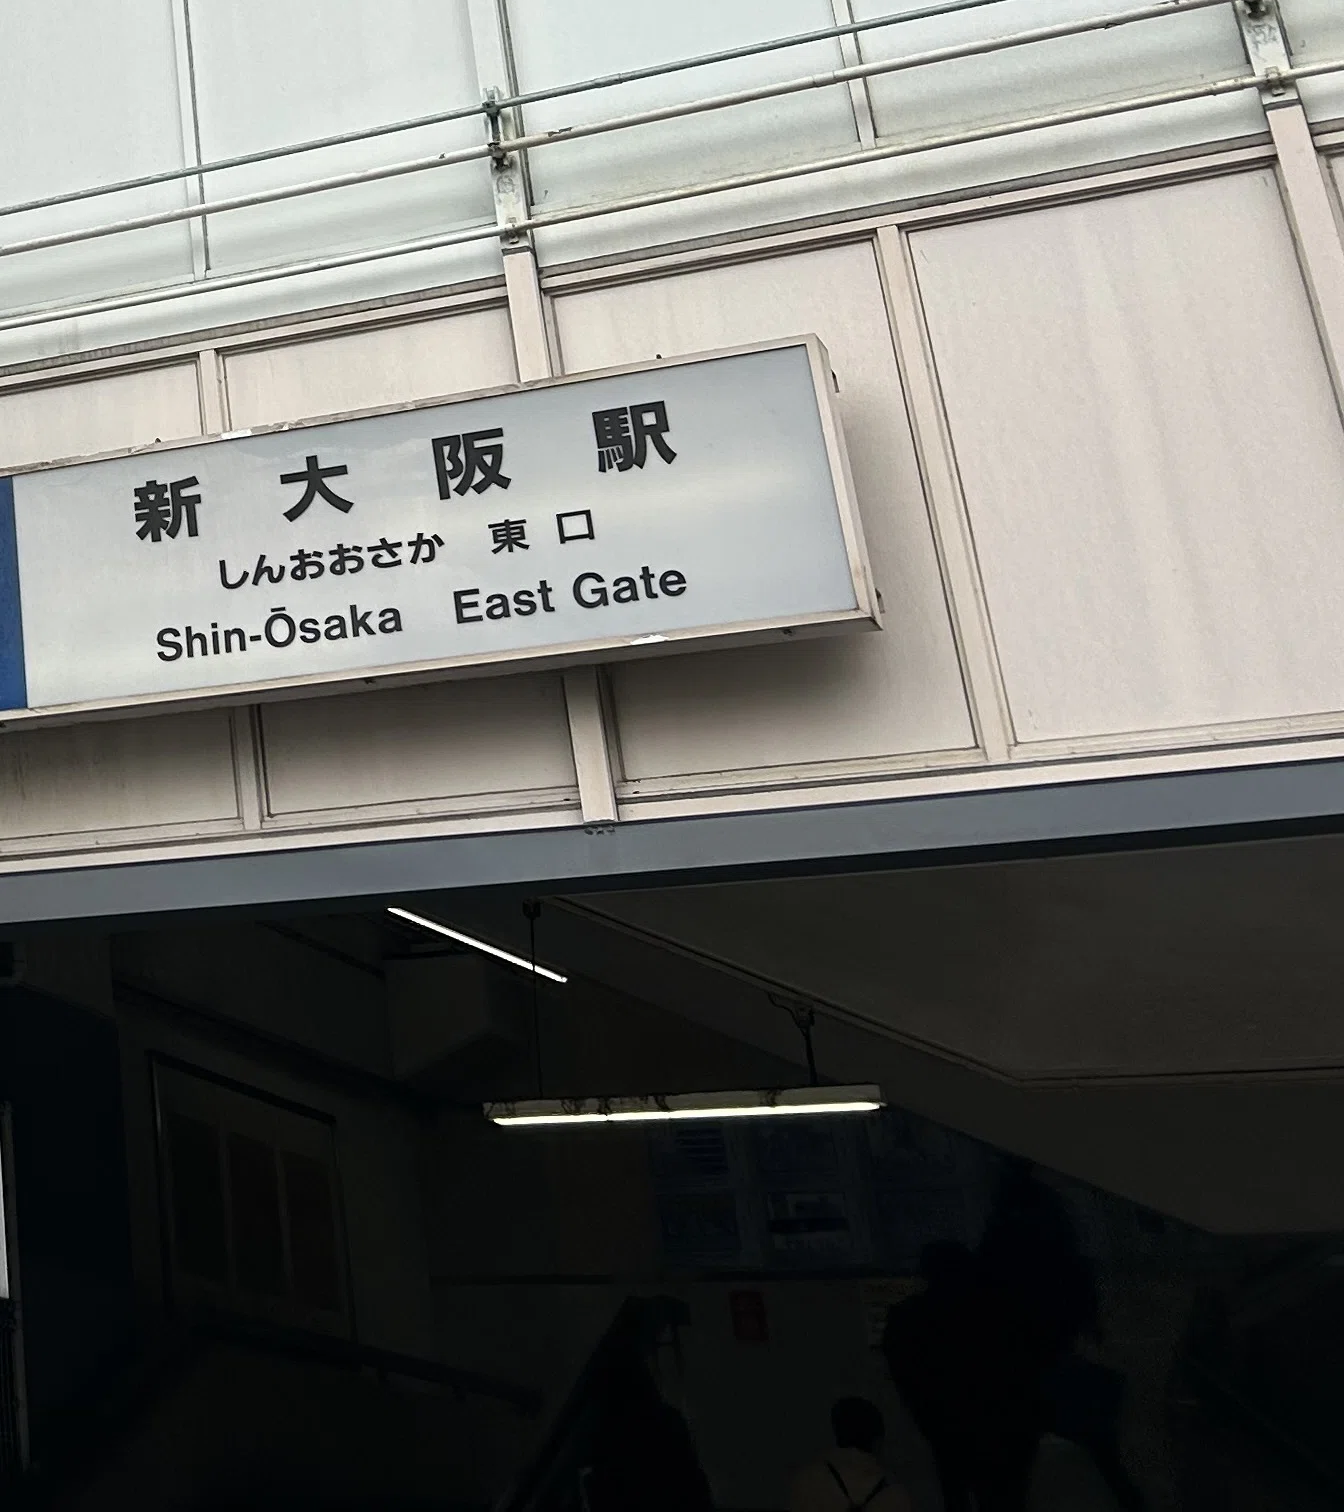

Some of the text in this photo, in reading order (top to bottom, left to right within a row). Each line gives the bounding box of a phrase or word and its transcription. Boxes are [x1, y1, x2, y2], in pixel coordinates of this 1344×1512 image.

[133, 400, 678, 543] 新大阪駅
[218, 509, 596, 590] しんおおさか 東口
[156, 565, 687, 662] Shin-Ōsaka East Gate
